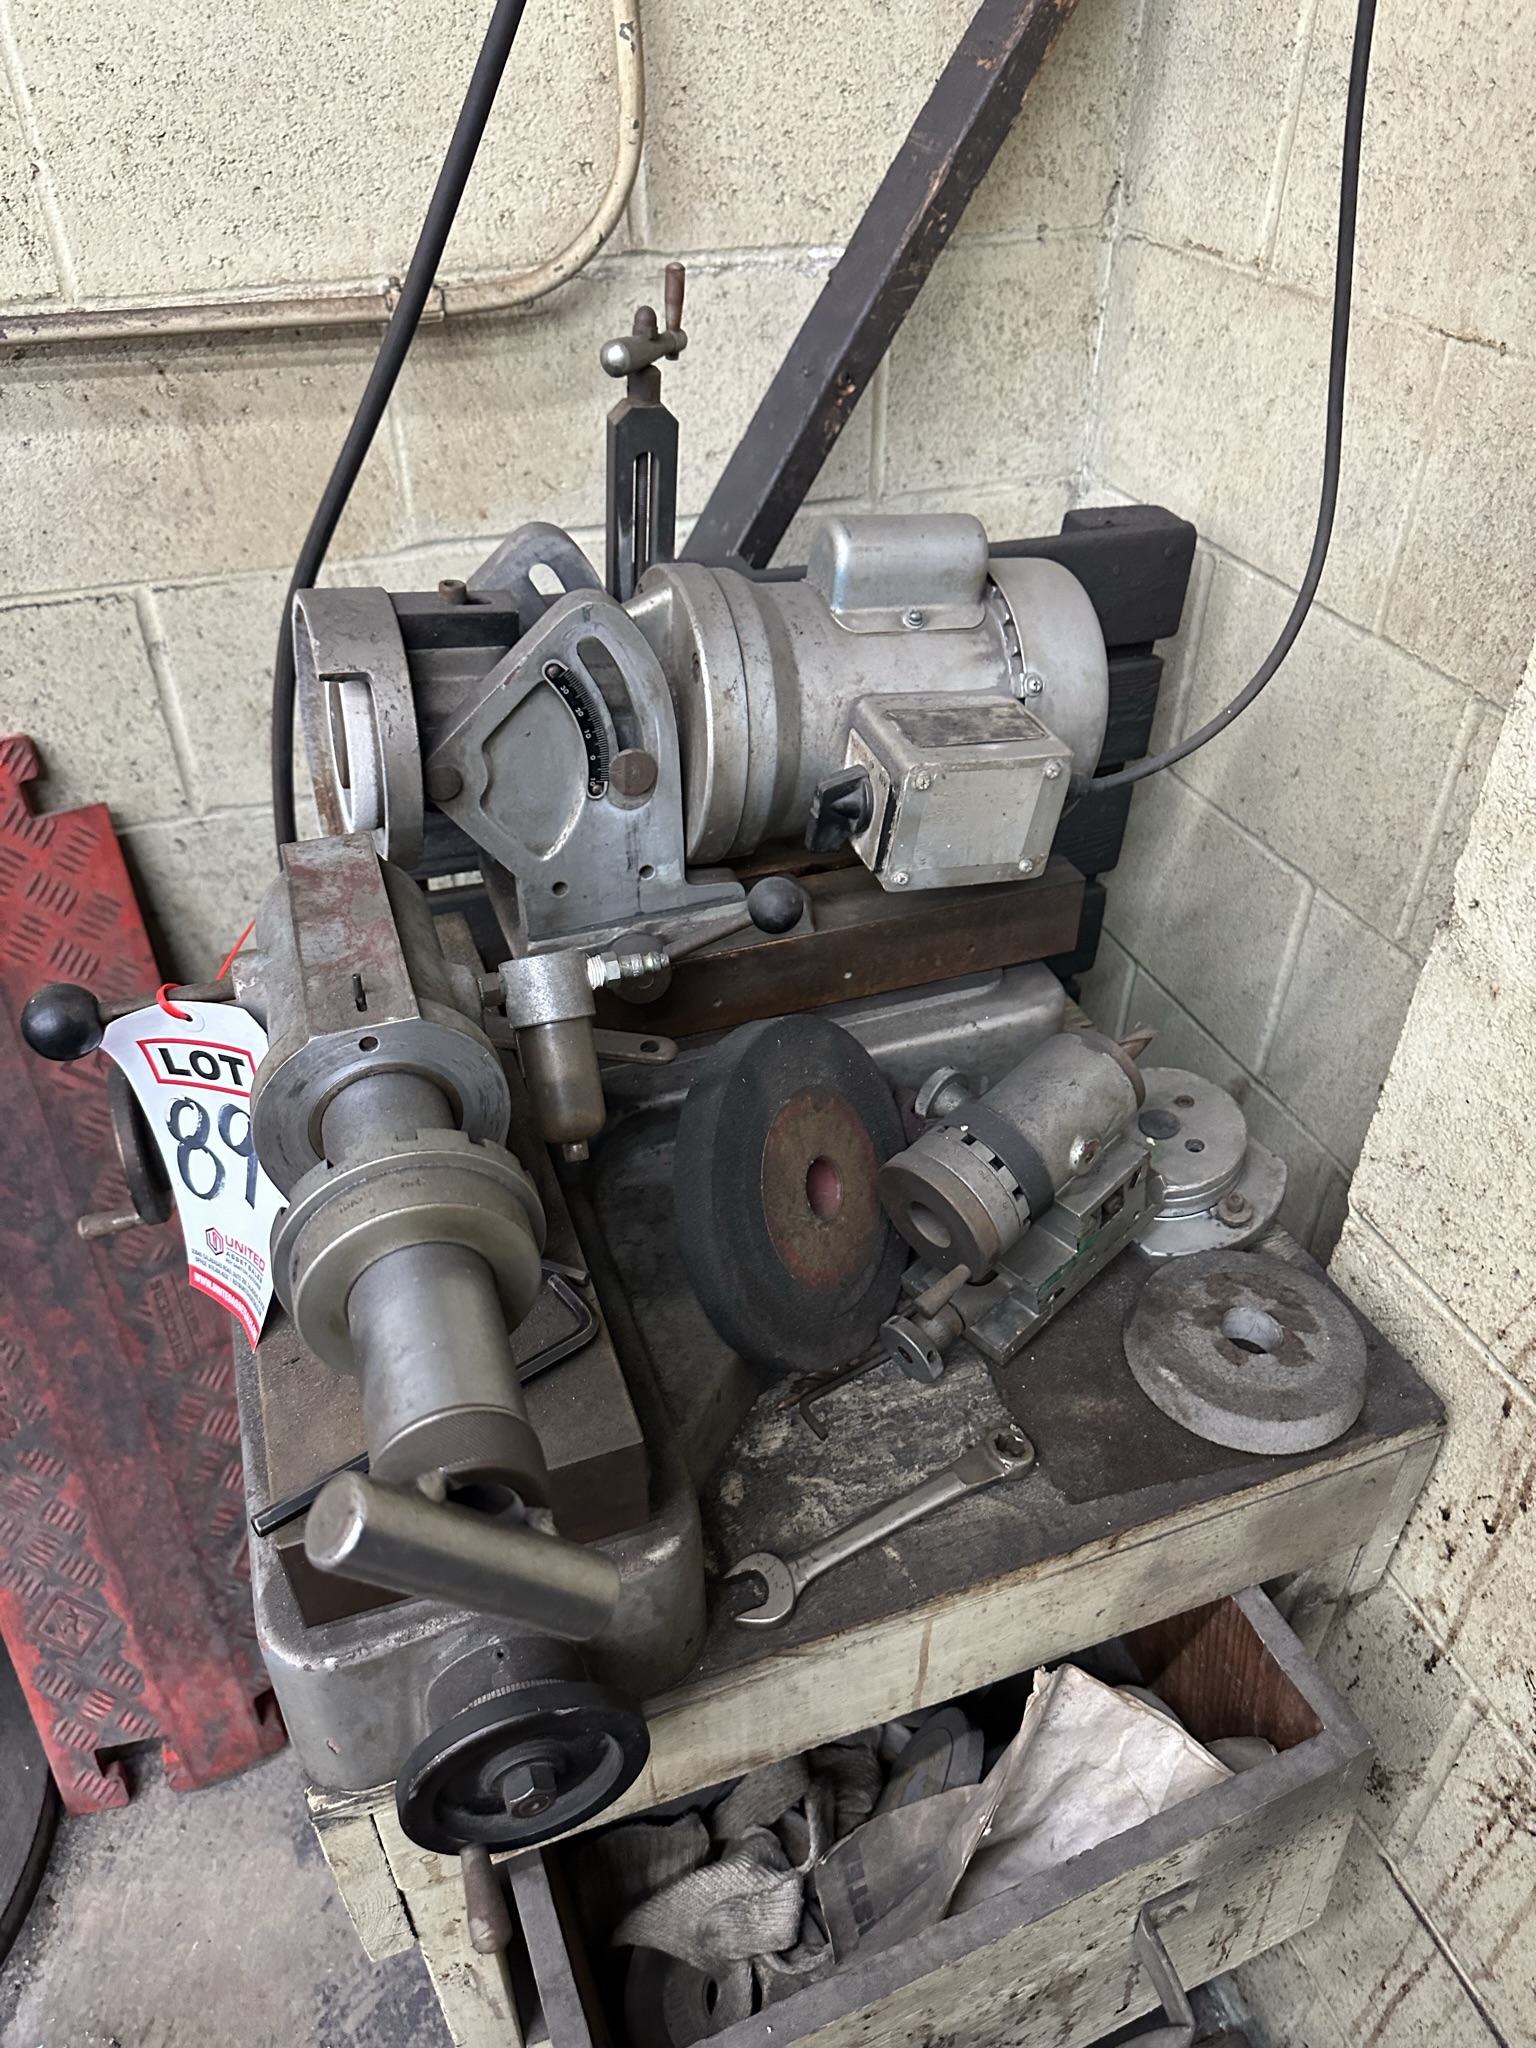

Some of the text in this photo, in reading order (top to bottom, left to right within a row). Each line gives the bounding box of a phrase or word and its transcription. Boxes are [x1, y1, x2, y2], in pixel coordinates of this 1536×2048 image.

[560, 685, 569, 695] 30
[575, 707, 584, 717] 20
[584, 729, 592, 739] 10
[157, 1047, 246, 1087] LOT
[224, 1234, 266, 1272] UNITED
[225, 1251, 248, 1267] ASSET
[247, 1265, 263, 1284] SALES
